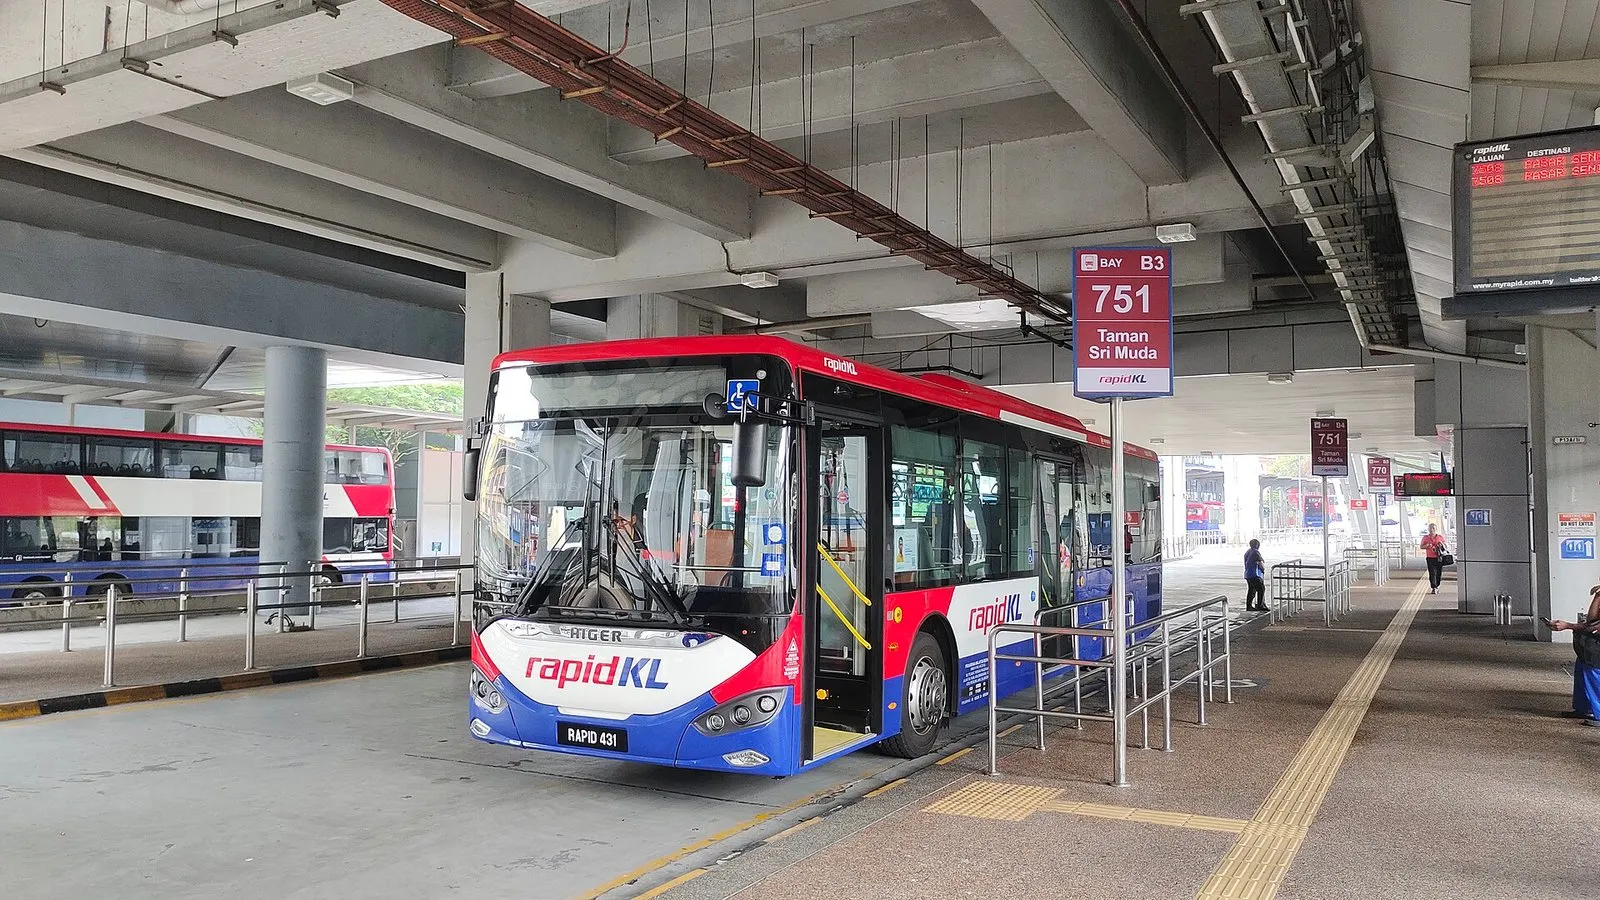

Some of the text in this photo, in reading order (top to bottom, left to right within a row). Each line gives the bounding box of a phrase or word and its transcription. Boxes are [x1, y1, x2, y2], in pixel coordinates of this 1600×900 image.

[1473, 144, 1511, 155] rapidKL
[1527, 147, 1571, 158] DESTINASI
[1473, 154, 1505, 163] LALUAN
[1524, 157, 1566, 169] PASAR
[1524, 168, 1566, 181] PASAR
[1100, 255, 1165, 271] BAY B3
[1473, 278, 1554, 290] www.myrapid.com.my
[1091, 284, 1150, 314] 751
[1097, 329, 1149, 343] Taman
[1088, 345, 1158, 360] Sri Muda
[823, 356, 858, 376] rapidKL
[1099, 373, 1147, 386] rapidKL
[1318, 433, 1341, 445] 751
[1371, 466, 1388, 475] 770
[968, 593, 1023, 635] rapidKL
[524, 654, 669, 691] rapidKL
[567, 727, 617, 748] RAPID 431
